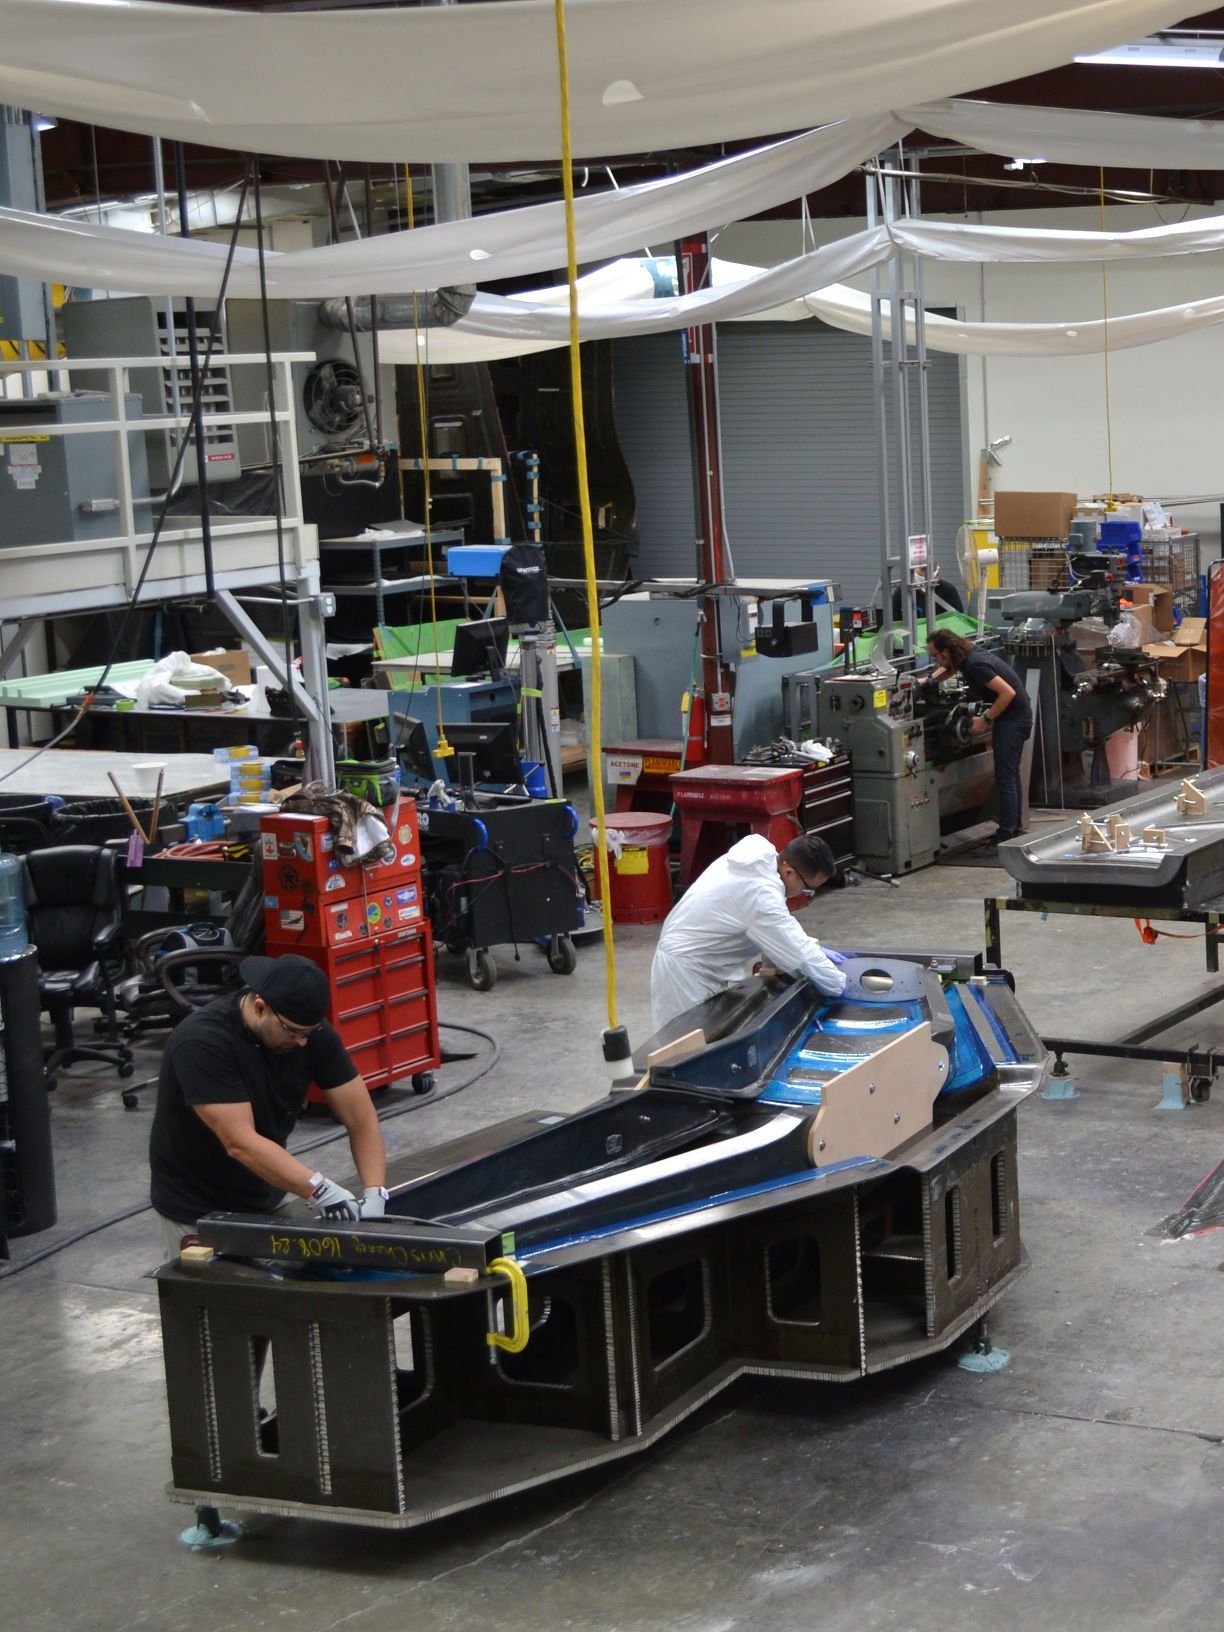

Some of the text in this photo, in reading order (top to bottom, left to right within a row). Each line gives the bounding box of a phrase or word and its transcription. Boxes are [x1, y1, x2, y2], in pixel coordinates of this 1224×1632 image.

[610, 760, 639, 768] ACETONE
[645, 758, 680, 770] FLAMMABL
[417, 812, 429, 826] RO
[271, 1234, 341, 1258] 1608.24
